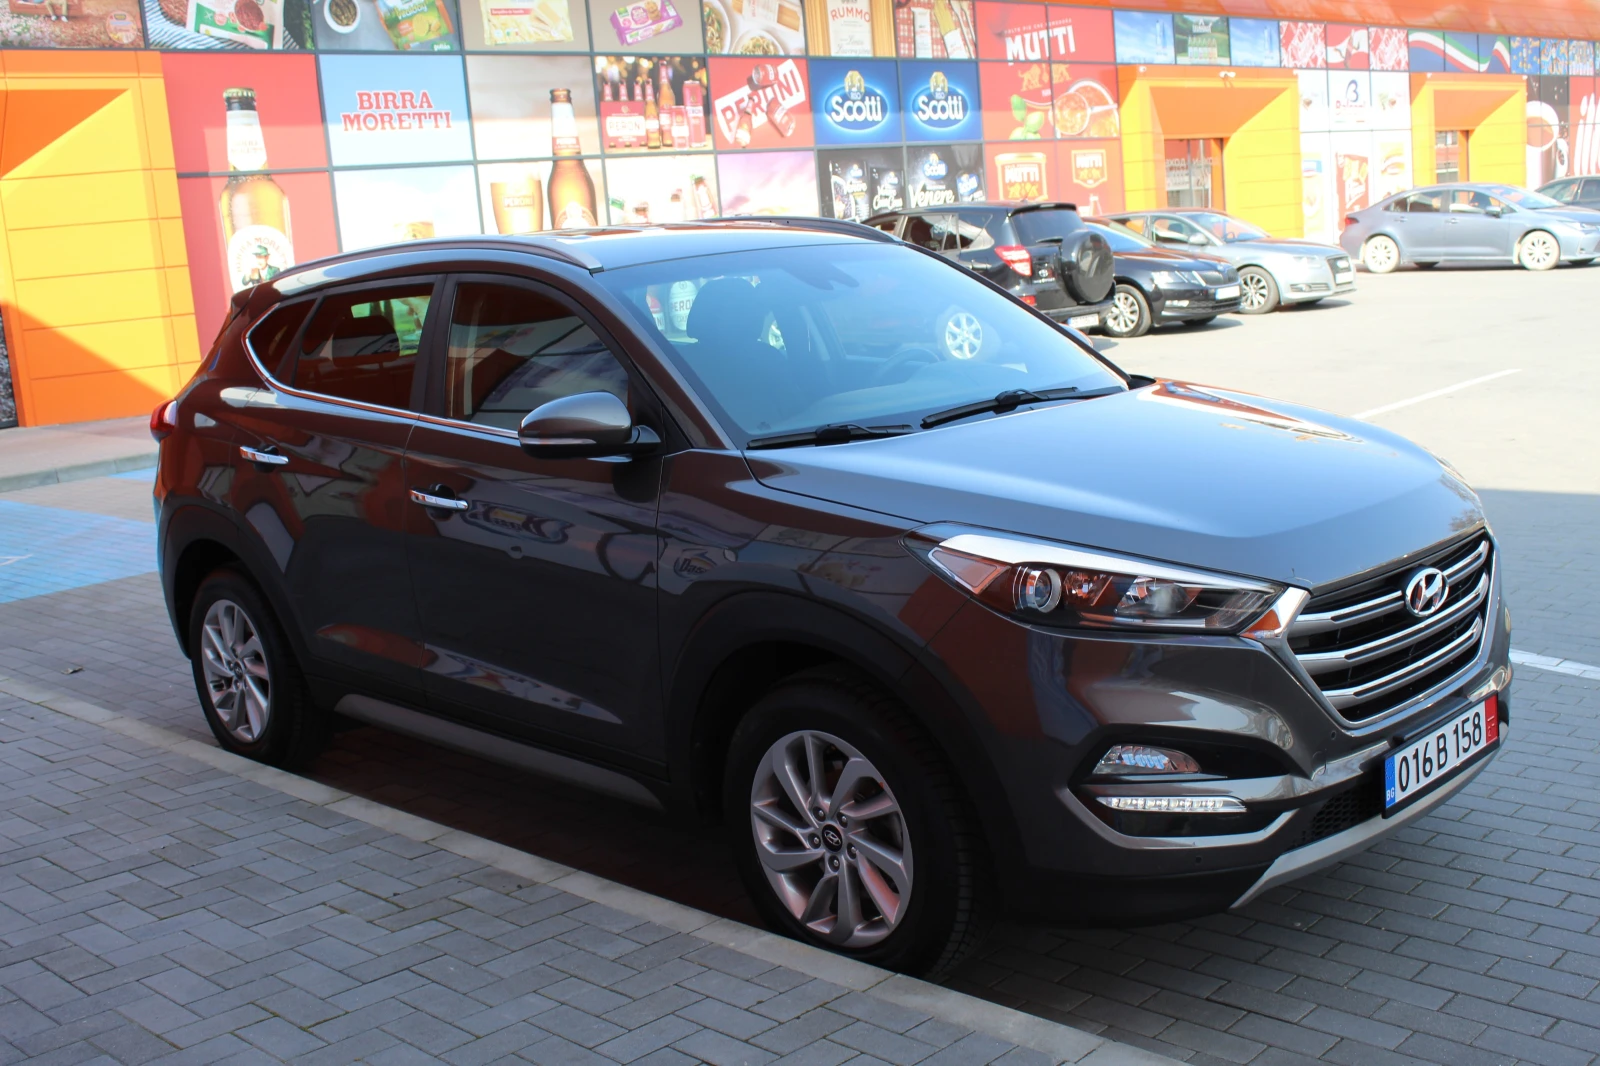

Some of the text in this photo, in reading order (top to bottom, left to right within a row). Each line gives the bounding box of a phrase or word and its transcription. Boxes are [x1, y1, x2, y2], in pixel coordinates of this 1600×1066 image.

[830, 7, 871, 23] RUMMO
[1005, 25, 1076, 66] MUTTI
[356, 90, 434, 111] BIRRA
[831, 95, 882, 123] Scotti
[918, 95, 964, 121] Scotti
[342, 111, 453, 132] MORETTI
[608, 120, 643, 132] PERON
[1574, 91, 1600, 176] ill
[1004, 166, 1040, 184] MUTTI
[908, 180, 955, 208] Venere
[1399, 741, 1433, 793] 016
[1436, 732, 1448, 771] B
[1452, 711, 1482, 759] 158
[1386, 787, 1395, 801] BG
